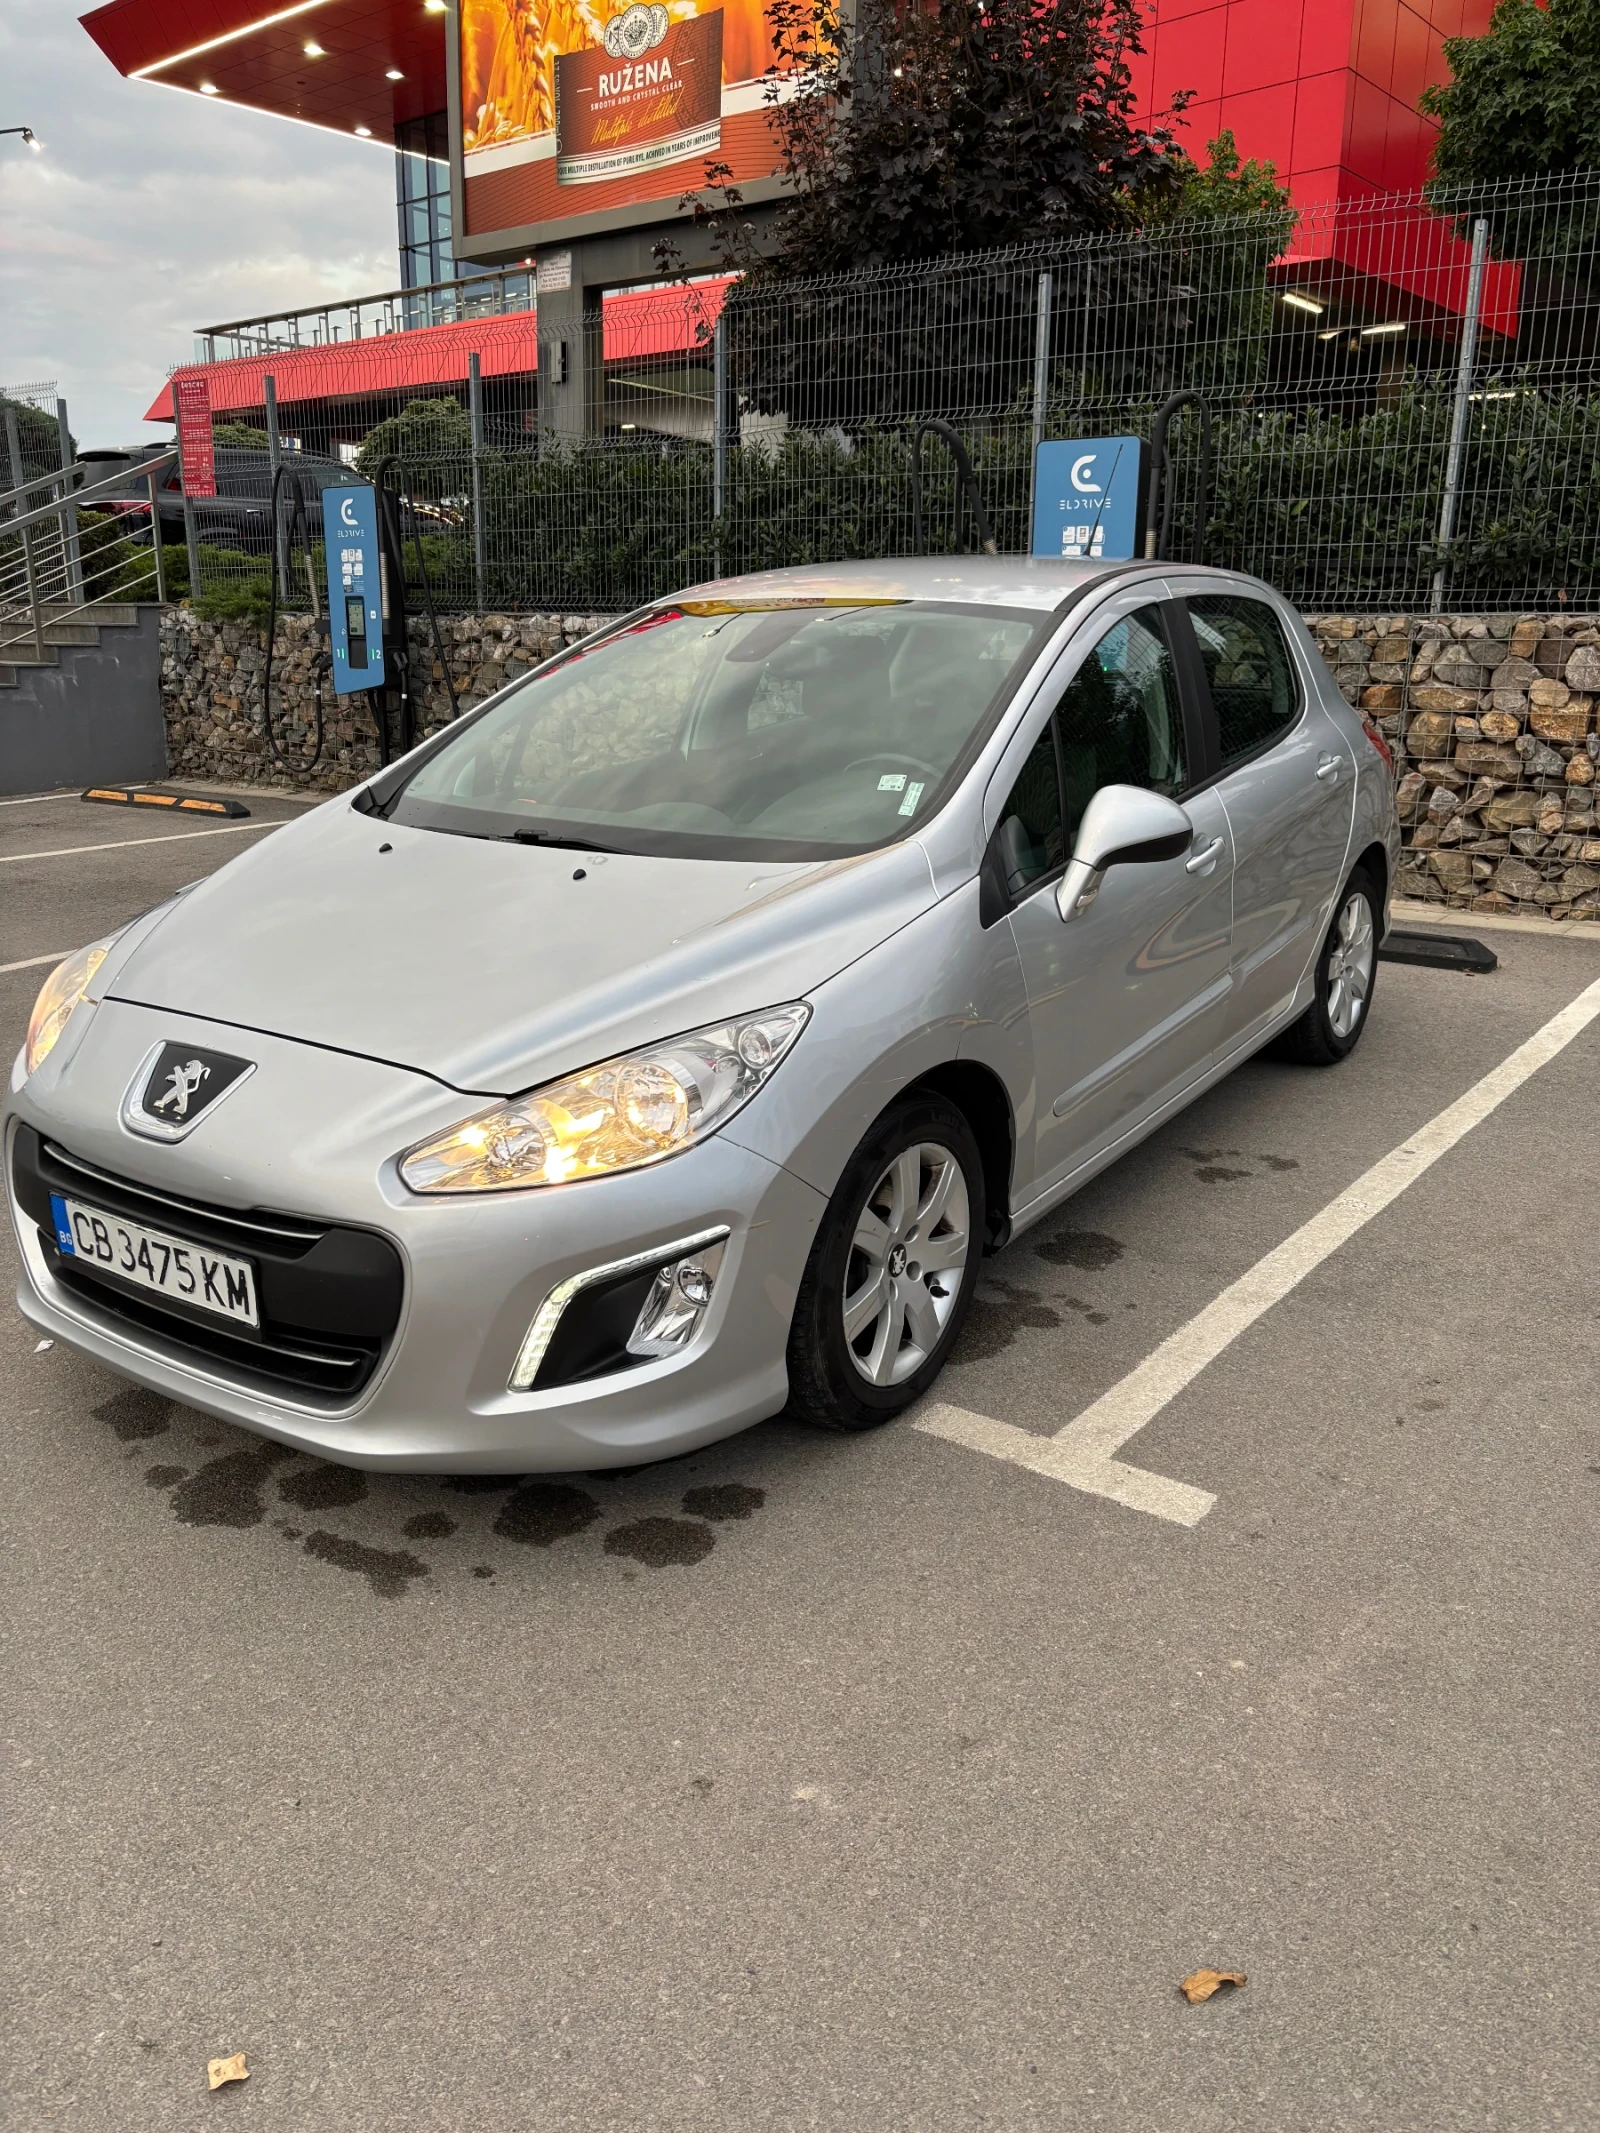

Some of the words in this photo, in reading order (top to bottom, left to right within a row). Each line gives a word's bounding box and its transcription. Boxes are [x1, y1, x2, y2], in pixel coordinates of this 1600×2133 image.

[598, 56, 673, 98] RUŽENA
[590, 99, 616, 112] SMOOTH
[617, 95, 631, 105] AND
[632, 88, 660, 101] CRYSTAL
[661, 79, 683, 93] CLEAR
[567, 164, 588, 174] MULTIPLE
[588, 160, 616, 172] DISTILLATION
[616, 157, 623, 166] OF
[623, 155, 635, 166] PURE
[665, 145, 671, 155] IN
[671, 141, 686, 153] YEARS
[686, 138, 693, 148] OF
[1059, 497, 1112, 510] ELDRIVE
[337, 529, 365, 538] ELDRIVE
[336, 648, 341, 658] 1
[375, 649, 382, 659] 2
[58, 1230, 73, 1247] BG
[116, 1227, 197, 1295] 3475
